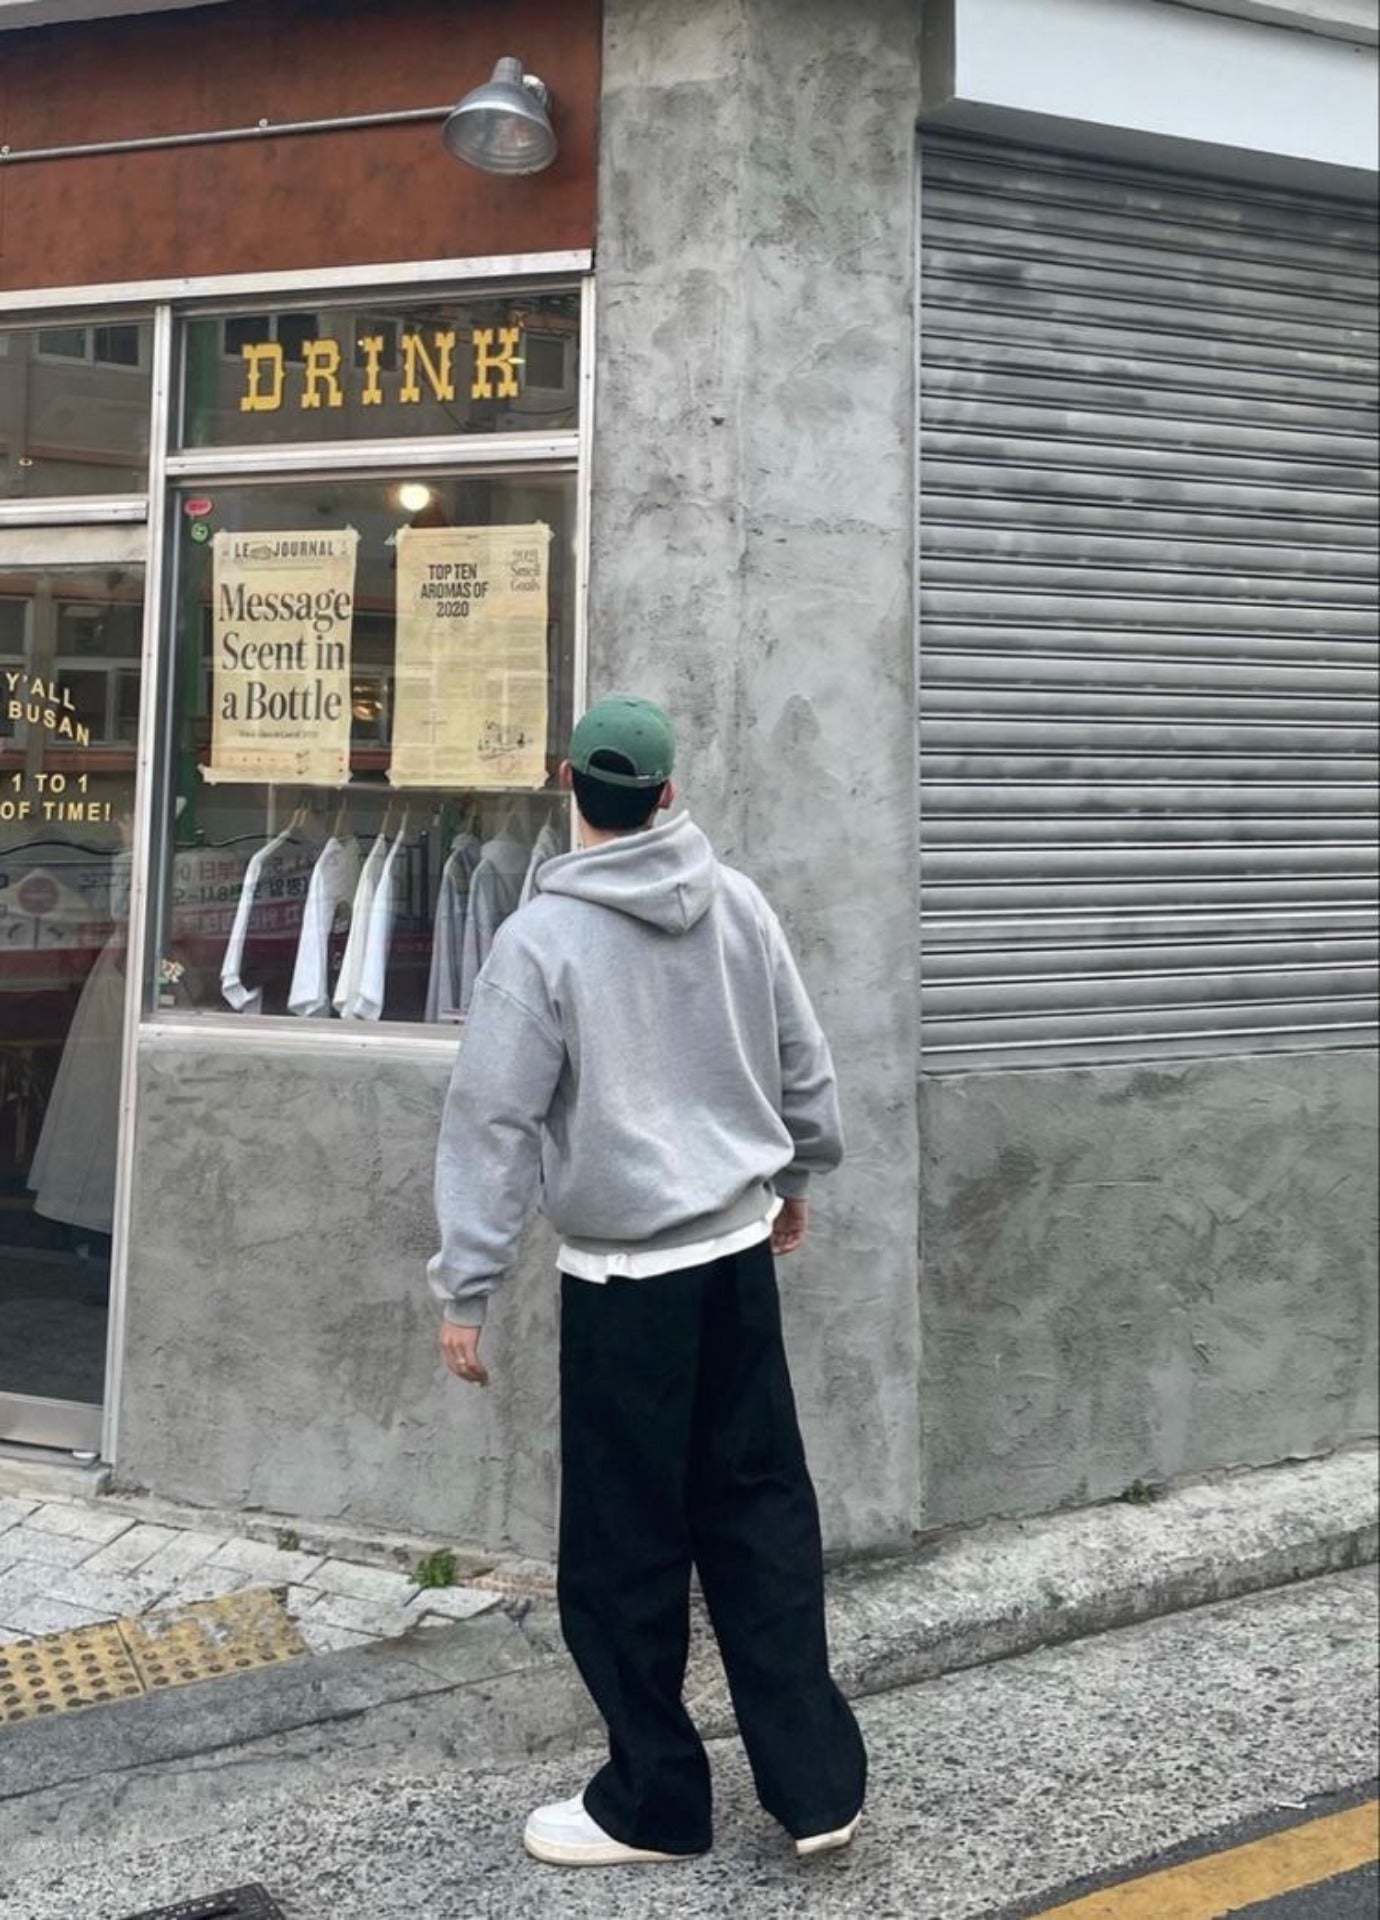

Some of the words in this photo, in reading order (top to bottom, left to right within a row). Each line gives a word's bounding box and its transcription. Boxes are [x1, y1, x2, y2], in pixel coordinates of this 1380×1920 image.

[240, 328, 519, 411] DRINK
[234, 542, 250, 560] LE
[273, 540, 334, 558] JOURNAL
[428, 563, 452, 581] TOP
[454, 562, 478, 580] TEN
[421, 582, 472, 600] AROMAS
[473, 581, 489, 599] OF
[219, 583, 351, 634] Message
[436, 601, 470, 619] 2020
[222, 631, 308, 671] Scent
[315, 634, 345, 671] in
[5, 672, 76, 711] Y'ALL
[221, 691, 239, 721] a
[245, 679, 343, 721] Bottle
[8, 700, 90, 747] BUSAN
[12, 772, 22, 793] 1
[34, 773, 67, 794] TO
[77, 773, 89, 794] 1
[0, 801, 31, 821] OF
[43, 802, 112, 821] TIME!
